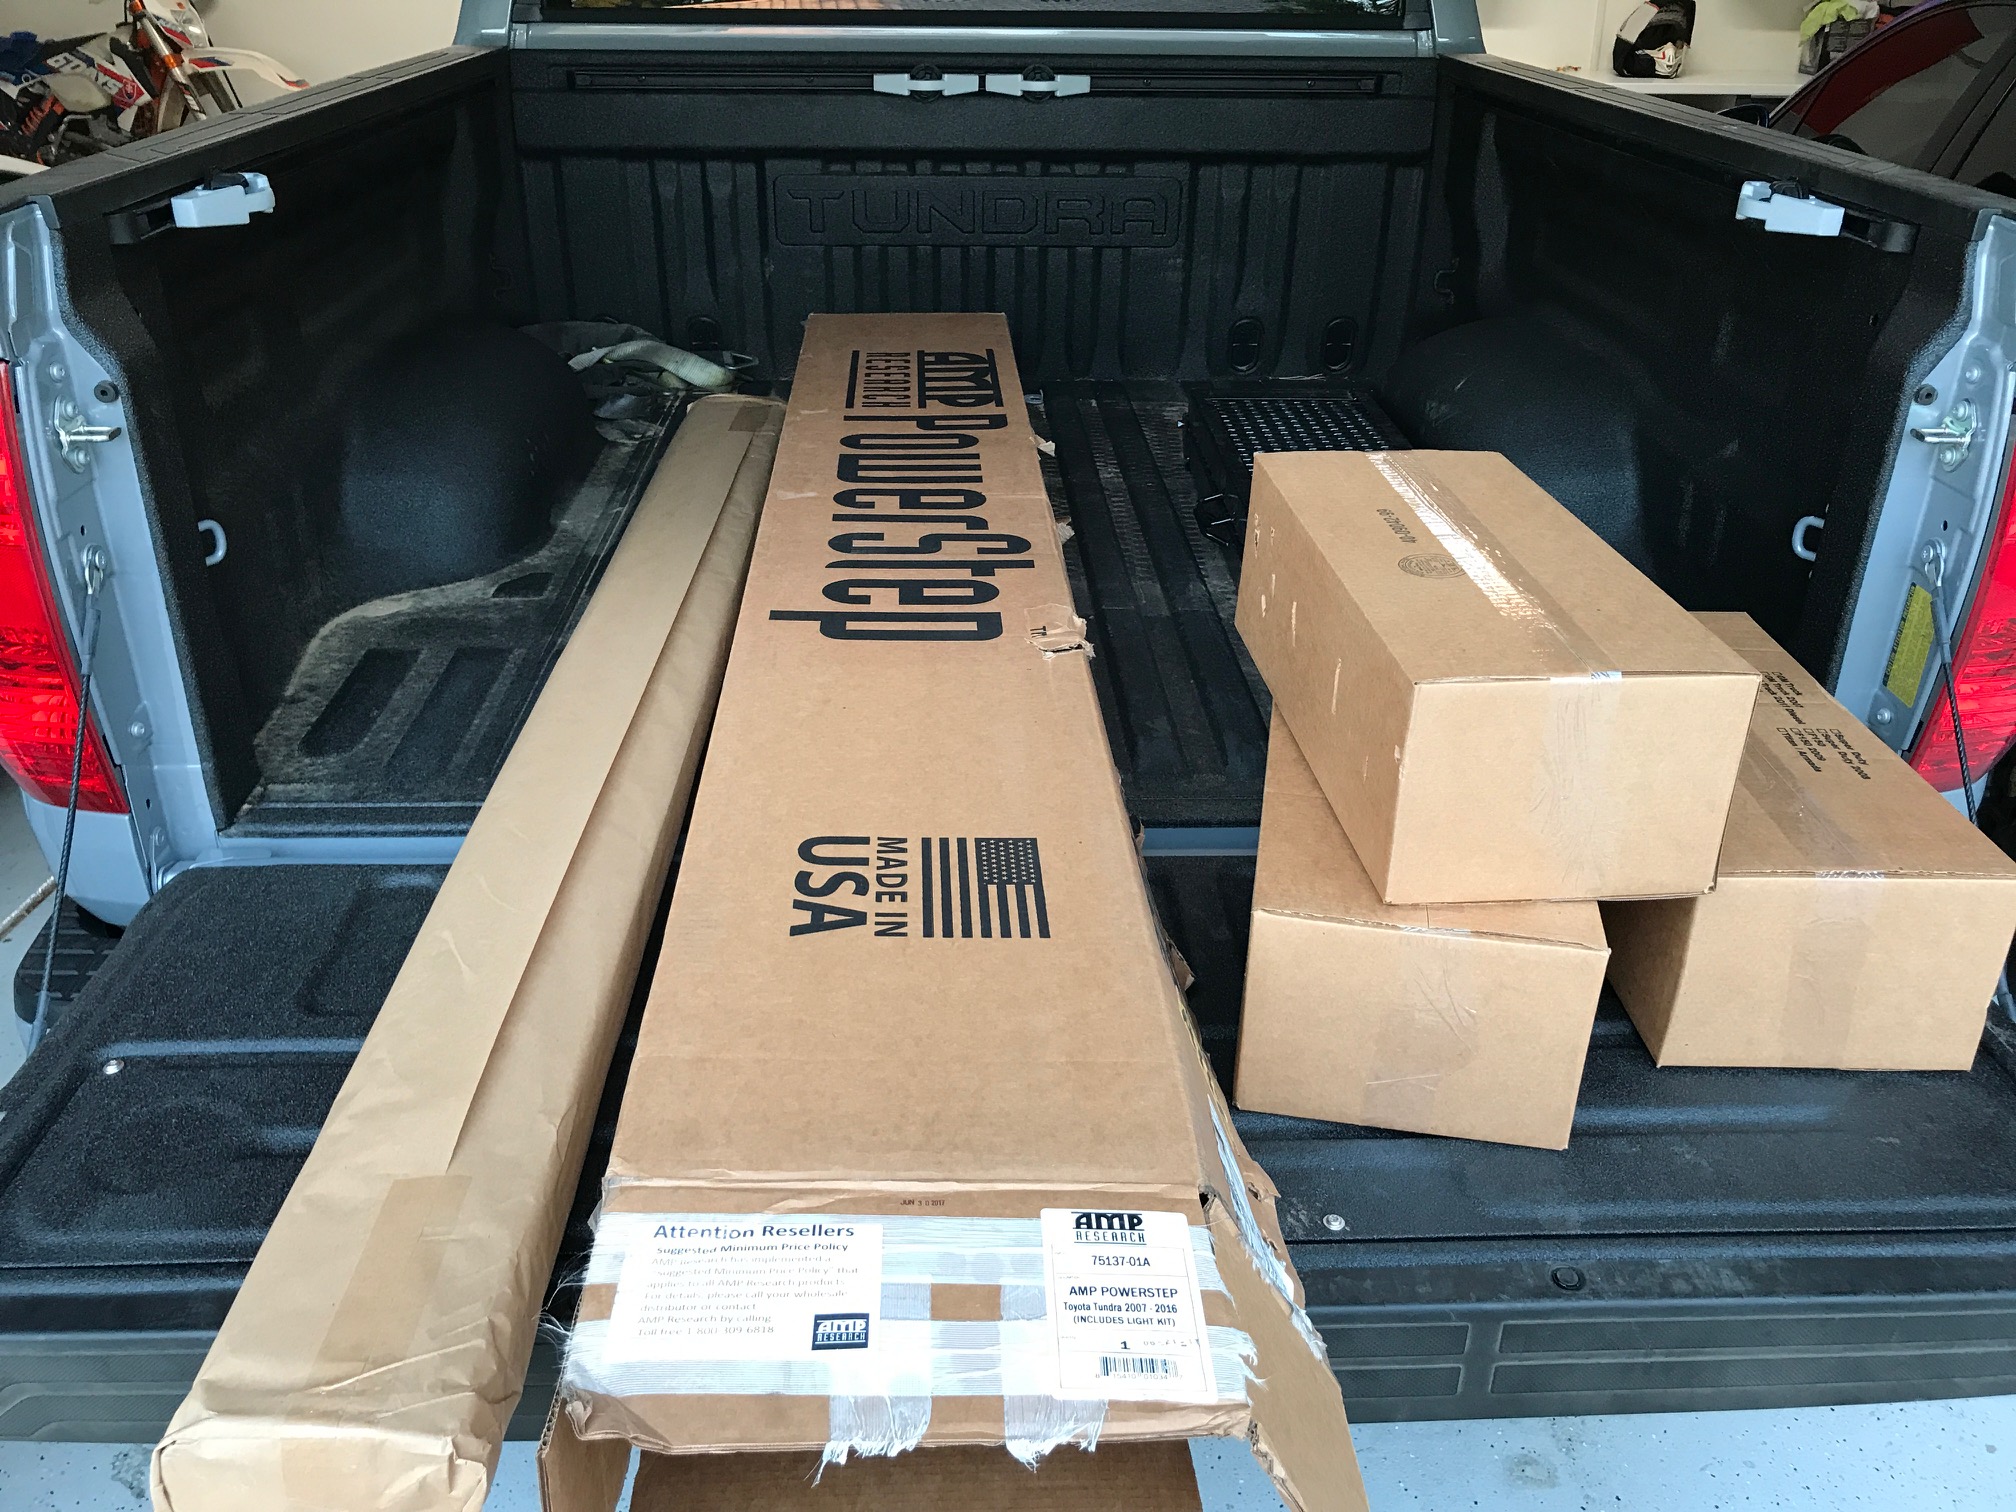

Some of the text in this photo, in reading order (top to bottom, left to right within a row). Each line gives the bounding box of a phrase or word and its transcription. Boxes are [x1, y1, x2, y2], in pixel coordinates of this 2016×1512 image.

[786, 188, 1169, 236] TUNDRA
[862, 352, 911, 408] RESEARCH
[917, 349, 1004, 408] AMP
[1773, 682, 1790, 696] Truck
[1785, 682, 1802, 696] Truck
[1821, 733, 1841, 750] Super
[1838, 751, 1855, 765] Duty
[1835, 734, 1869, 766] Super Duty
[789, 835, 870, 937] USA
[874, 836, 908, 937] MADE IN
[1074, 1212, 1143, 1231] AMP
[653, 1224, 855, 1240] Attention Resellers
[1075, 1231, 1146, 1242] RESEARCH
[656, 1243, 849, 1255] Suggested Minimum Price Policy
[651, 1258, 677, 1266] AMP
[751, 1256, 822, 1264] implemented
[1091, 1255, 1151, 1267] 75137-01A
[714, 1267, 766, 1275] Minimum
[769, 1267, 795, 1275] Price
[646, 1280, 685, 1289] applies
[717, 1279, 744, 1287] AMP
[746, 1279, 795, 1287] Research
[797, 1278, 846, 1288] products
[644, 1292, 661, 1300] For
[707, 1291, 743, 1300] please
[745, 1291, 764, 1299] call
[766, 1290, 790, 1300] your
[794, 1289, 848, 1298] wholesale
[1069, 1286, 1178, 1298] AMP POWERSTEP
[640, 1304, 697, 1312] distributor
[715, 1304, 756, 1312] contact
[1063, 1301, 1091, 1312] Toyota
[1093, 1302, 1122, 1312] Tundra
[1124, 1302, 1147, 1313] 2007
[1154, 1303, 1178, 1313] 2016
[638, 1314, 772, 1324] AMP Research by calling
[1073, 1315, 1176, 1327] (INCLUDES LIGHT KIT)
[817, 1319, 867, 1332] AMP
[638, 1328, 658, 1336] Toll
[660, 1328, 683, 1336] free
[816, 1332, 866, 1342] RESEARCH
[1120, 1340, 1131, 1350] 1
